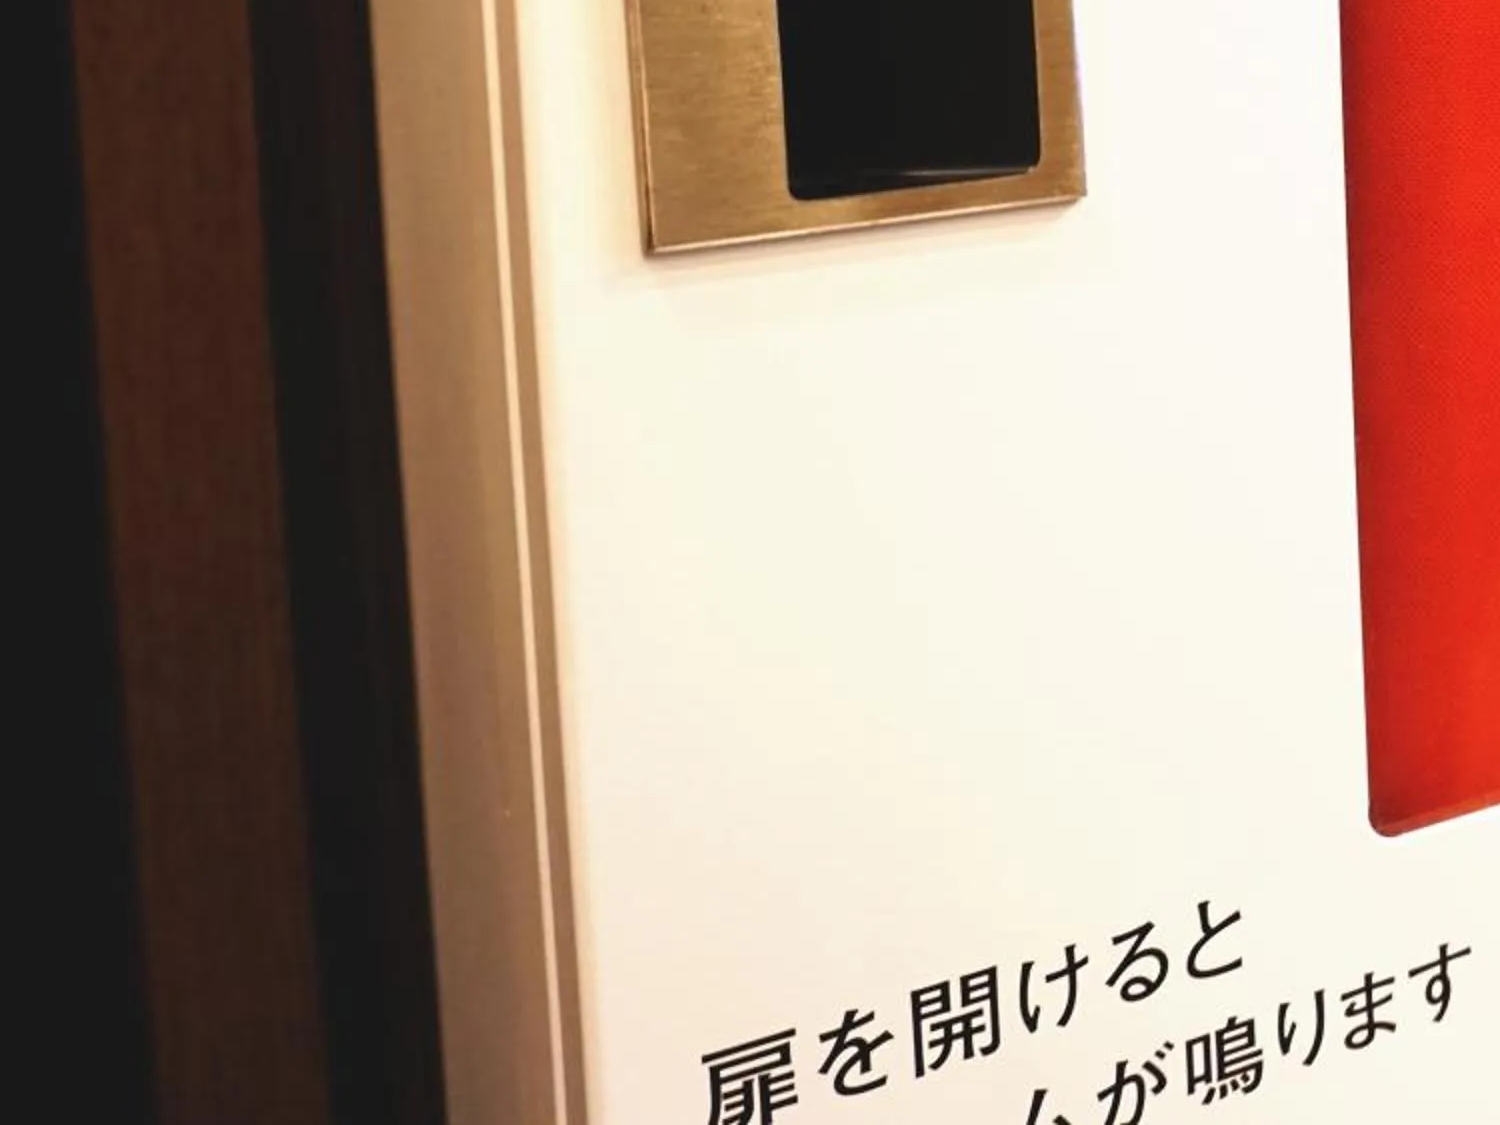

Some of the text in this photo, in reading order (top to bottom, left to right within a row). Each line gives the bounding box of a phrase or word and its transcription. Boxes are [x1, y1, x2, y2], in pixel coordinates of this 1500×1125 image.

[701, 900, 1244, 1125] 扉を開けると
